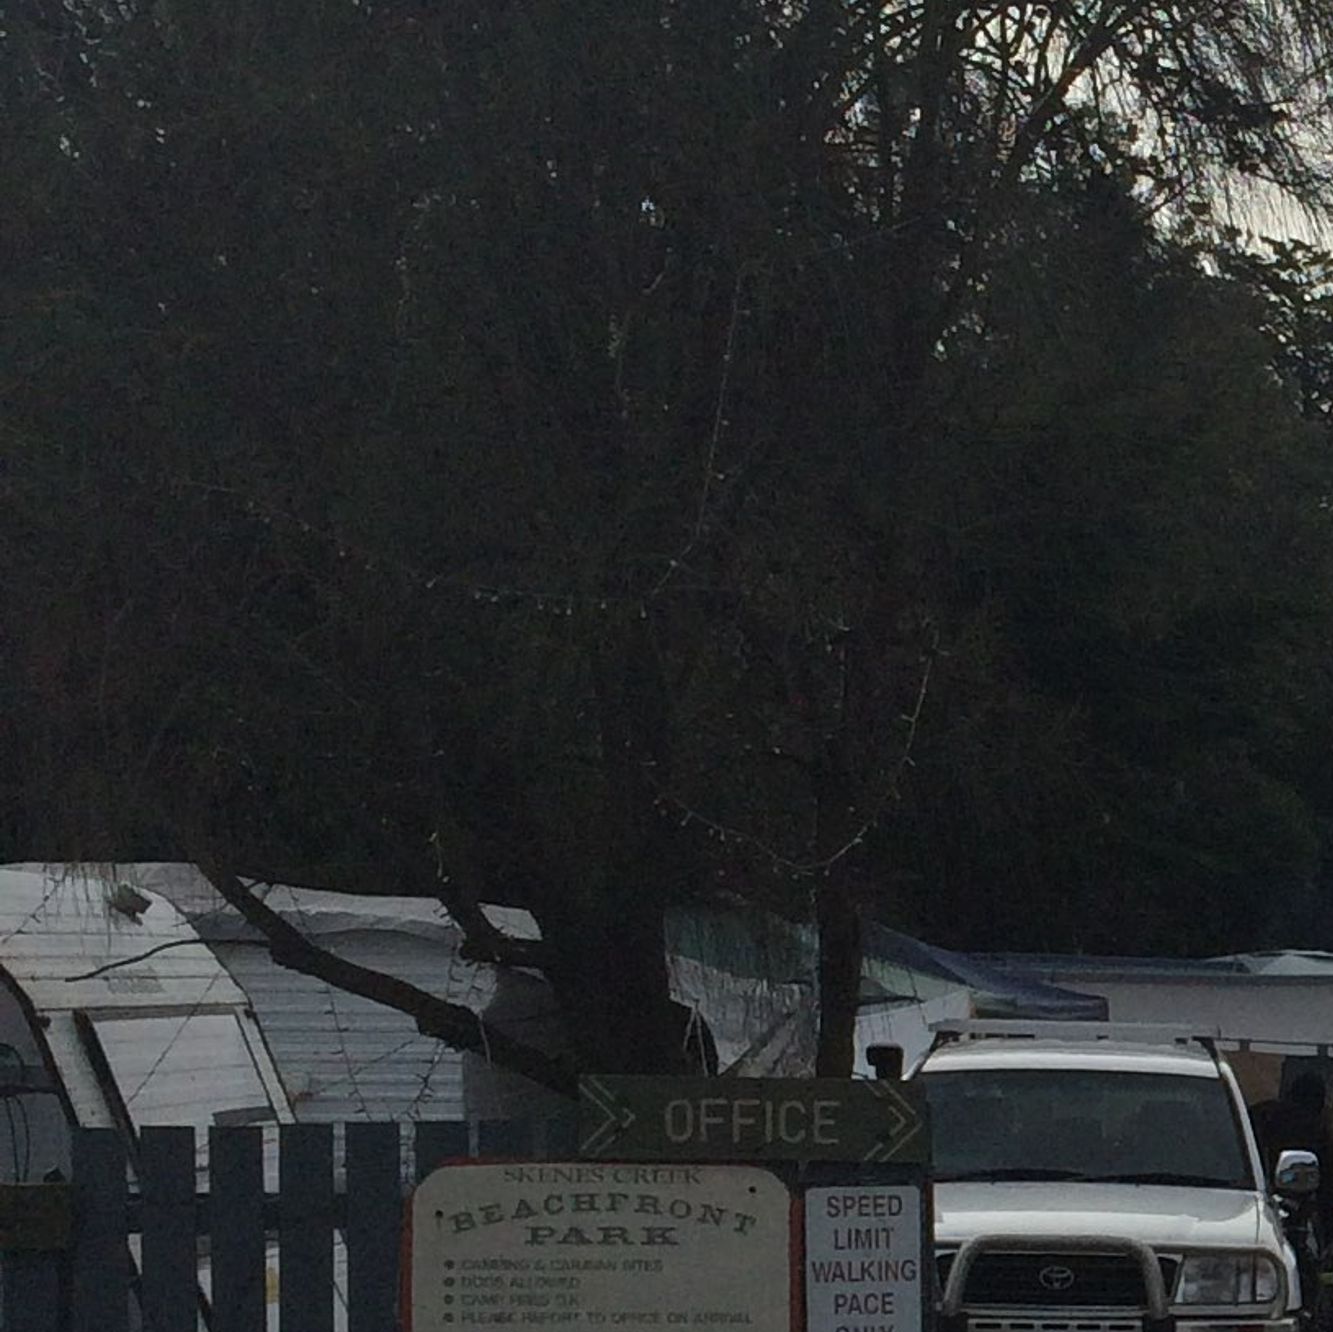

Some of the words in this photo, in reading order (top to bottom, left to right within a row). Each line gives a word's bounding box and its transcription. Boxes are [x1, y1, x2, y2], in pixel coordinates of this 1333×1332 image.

[664, 1098, 840, 1145] OFFICE
[449, 1193, 757, 1235] BEACHFRONT
[826, 1195, 903, 1218] SPEED
[525, 1226, 680, 1246] PARK
[833, 1228, 894, 1251] LIMIT
[811, 1259, 917, 1283] WALKING
[834, 1292, 895, 1315] PACE
